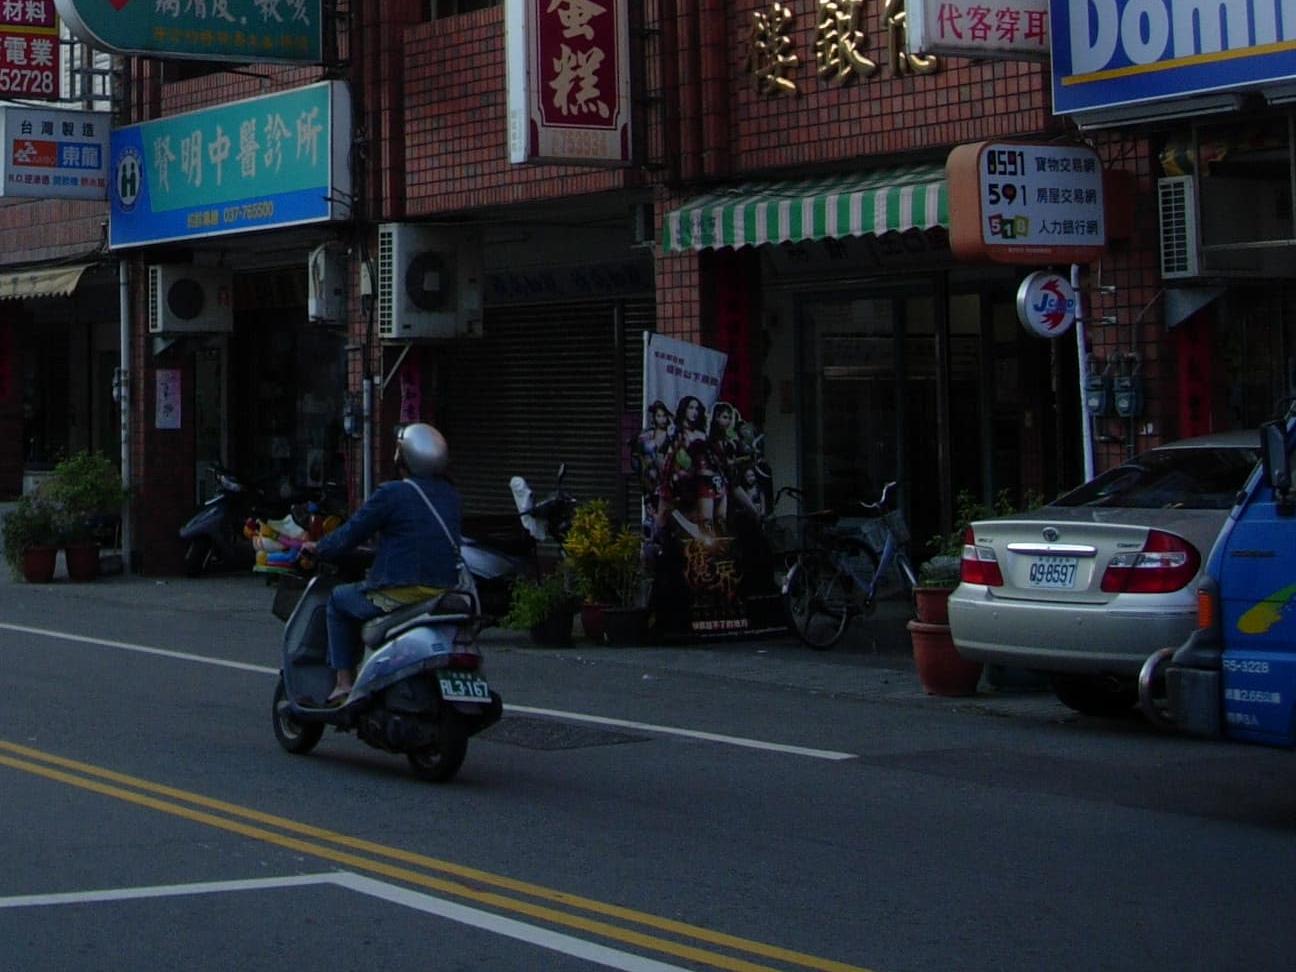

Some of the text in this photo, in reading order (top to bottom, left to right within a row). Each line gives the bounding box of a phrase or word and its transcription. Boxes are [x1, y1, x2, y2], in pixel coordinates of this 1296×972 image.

[937, 3, 1048, 46] 代客穿耳
[154, 106, 323, 193] 賢明中醫診所
[988, 183, 1027, 206] 591
